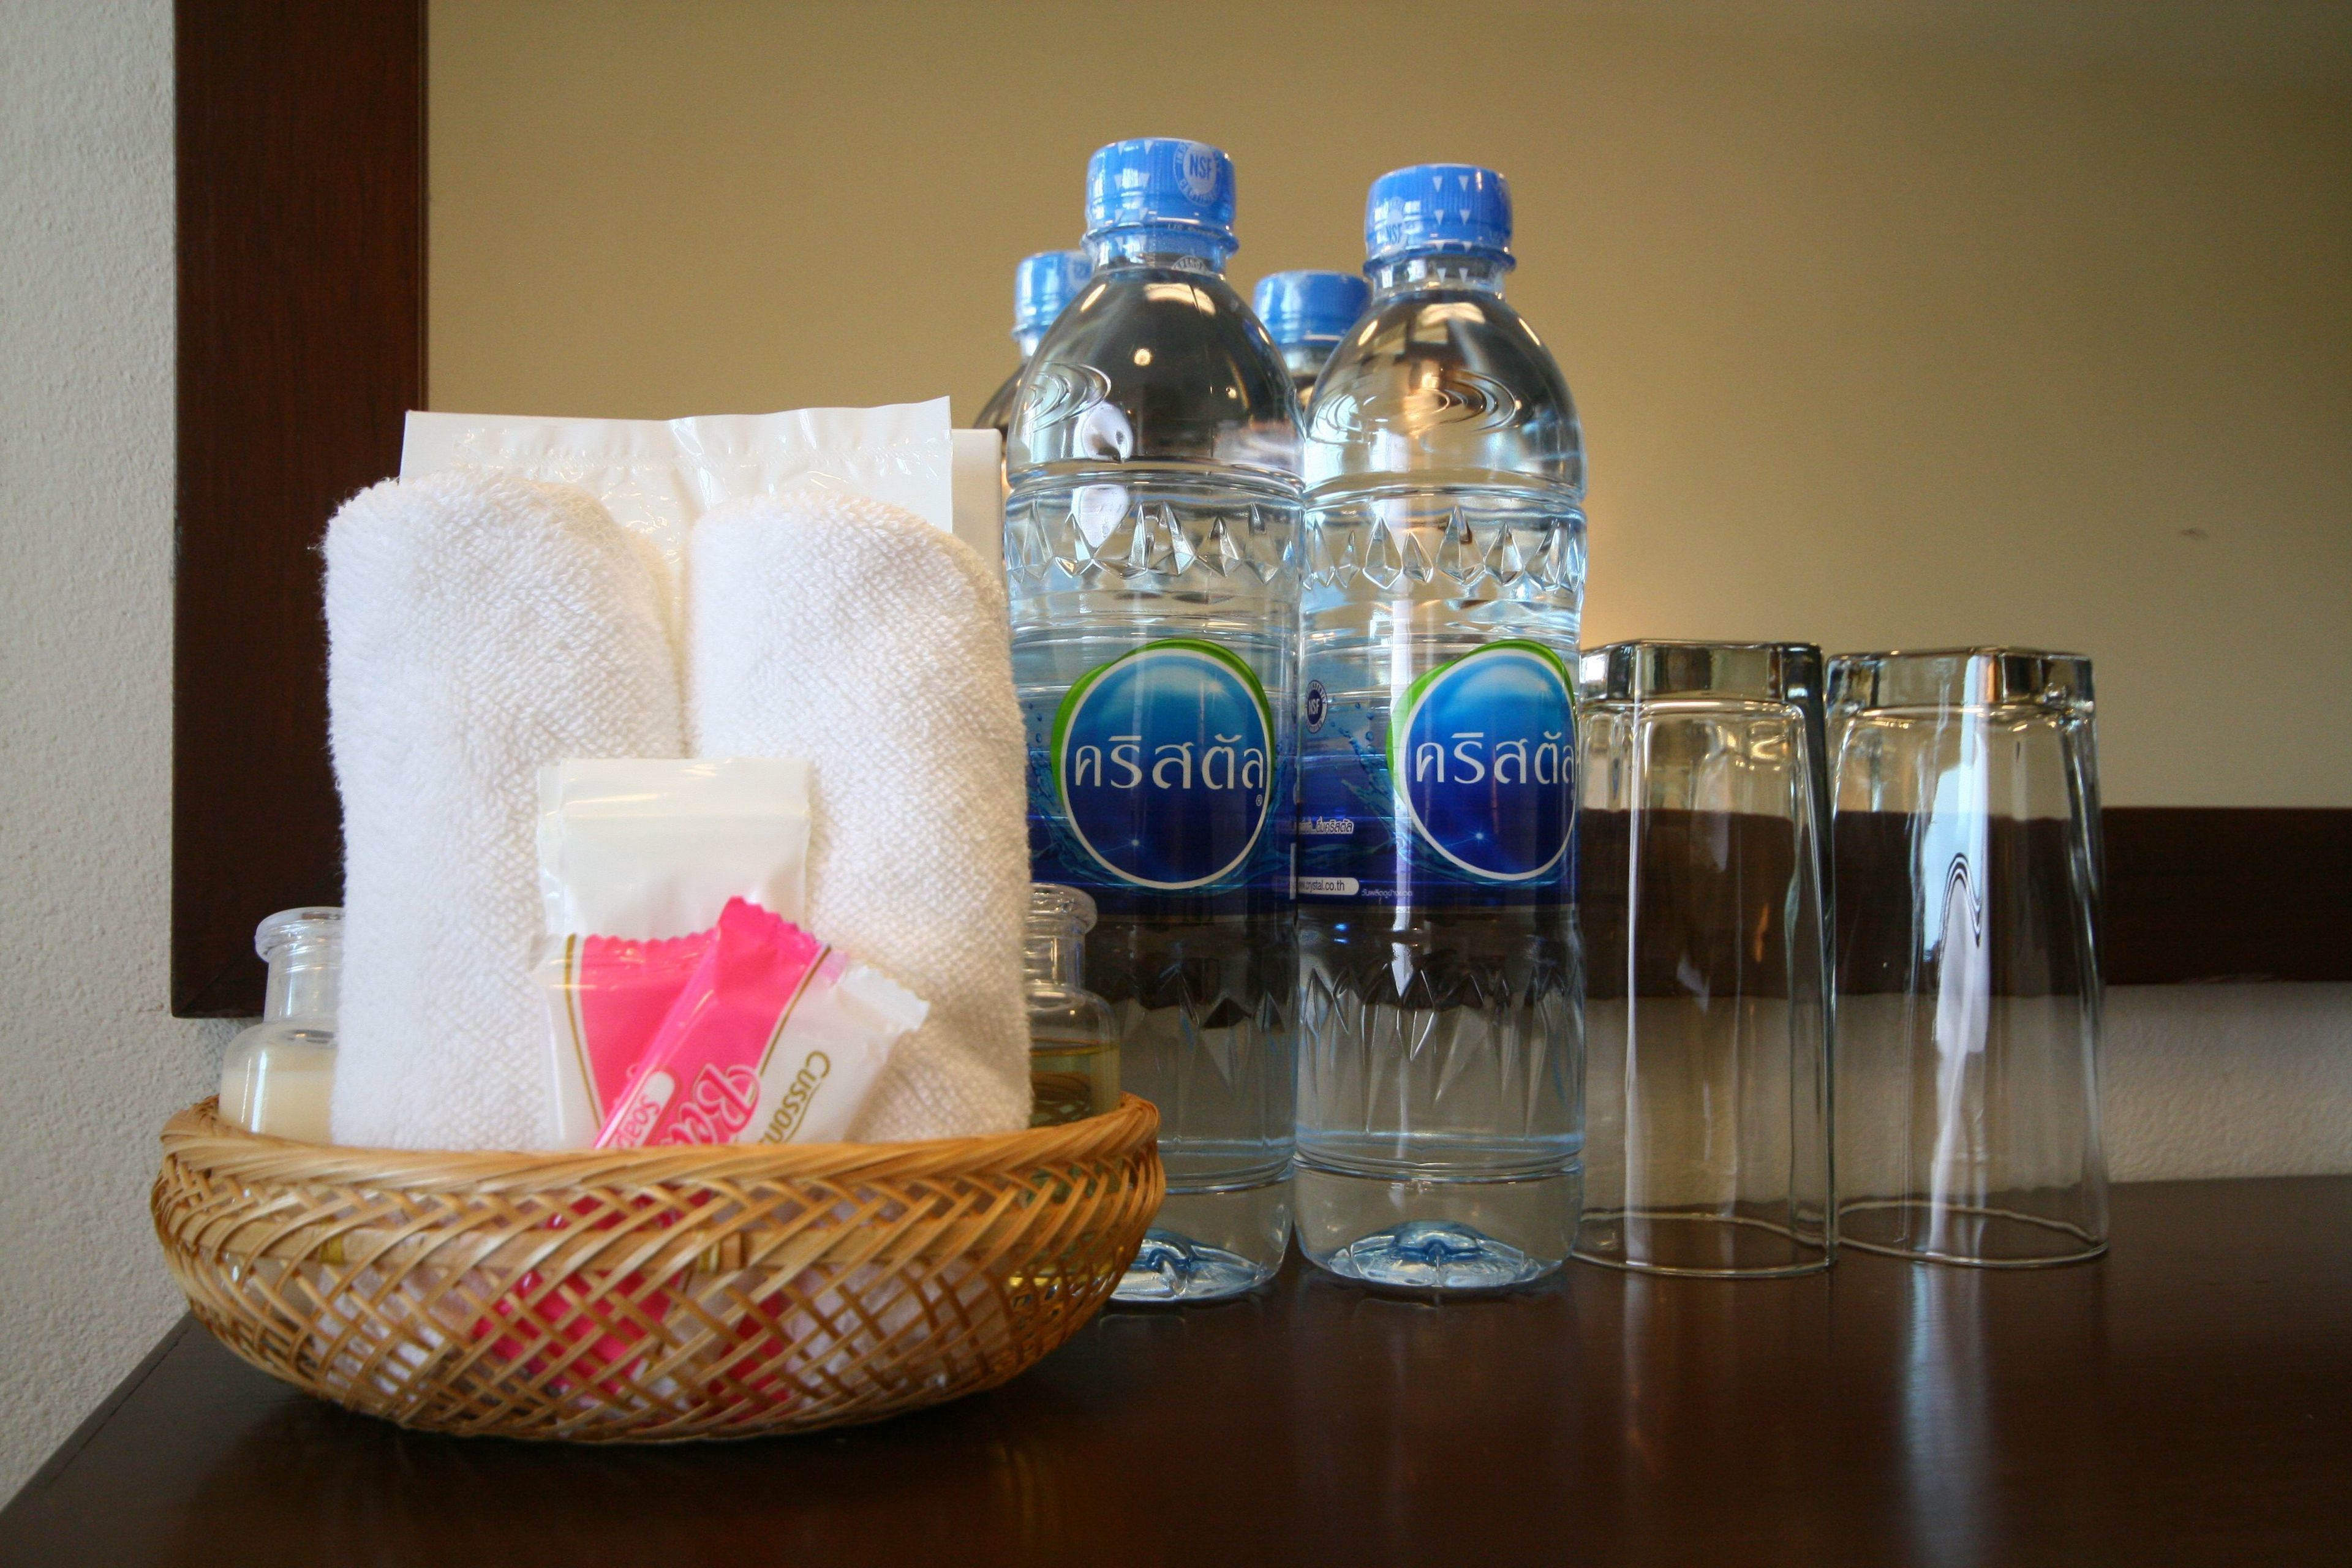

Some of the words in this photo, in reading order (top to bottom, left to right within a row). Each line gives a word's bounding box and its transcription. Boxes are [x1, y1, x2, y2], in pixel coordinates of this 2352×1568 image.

[1189, 153, 1213, 180] NSF
[1308, 698, 1321, 715] NSF
[1074, 734, 1264, 790] คริสตัล
[1415, 731, 1575, 784] คริสตัล
[758, 1050, 831, 1144] Cusson
